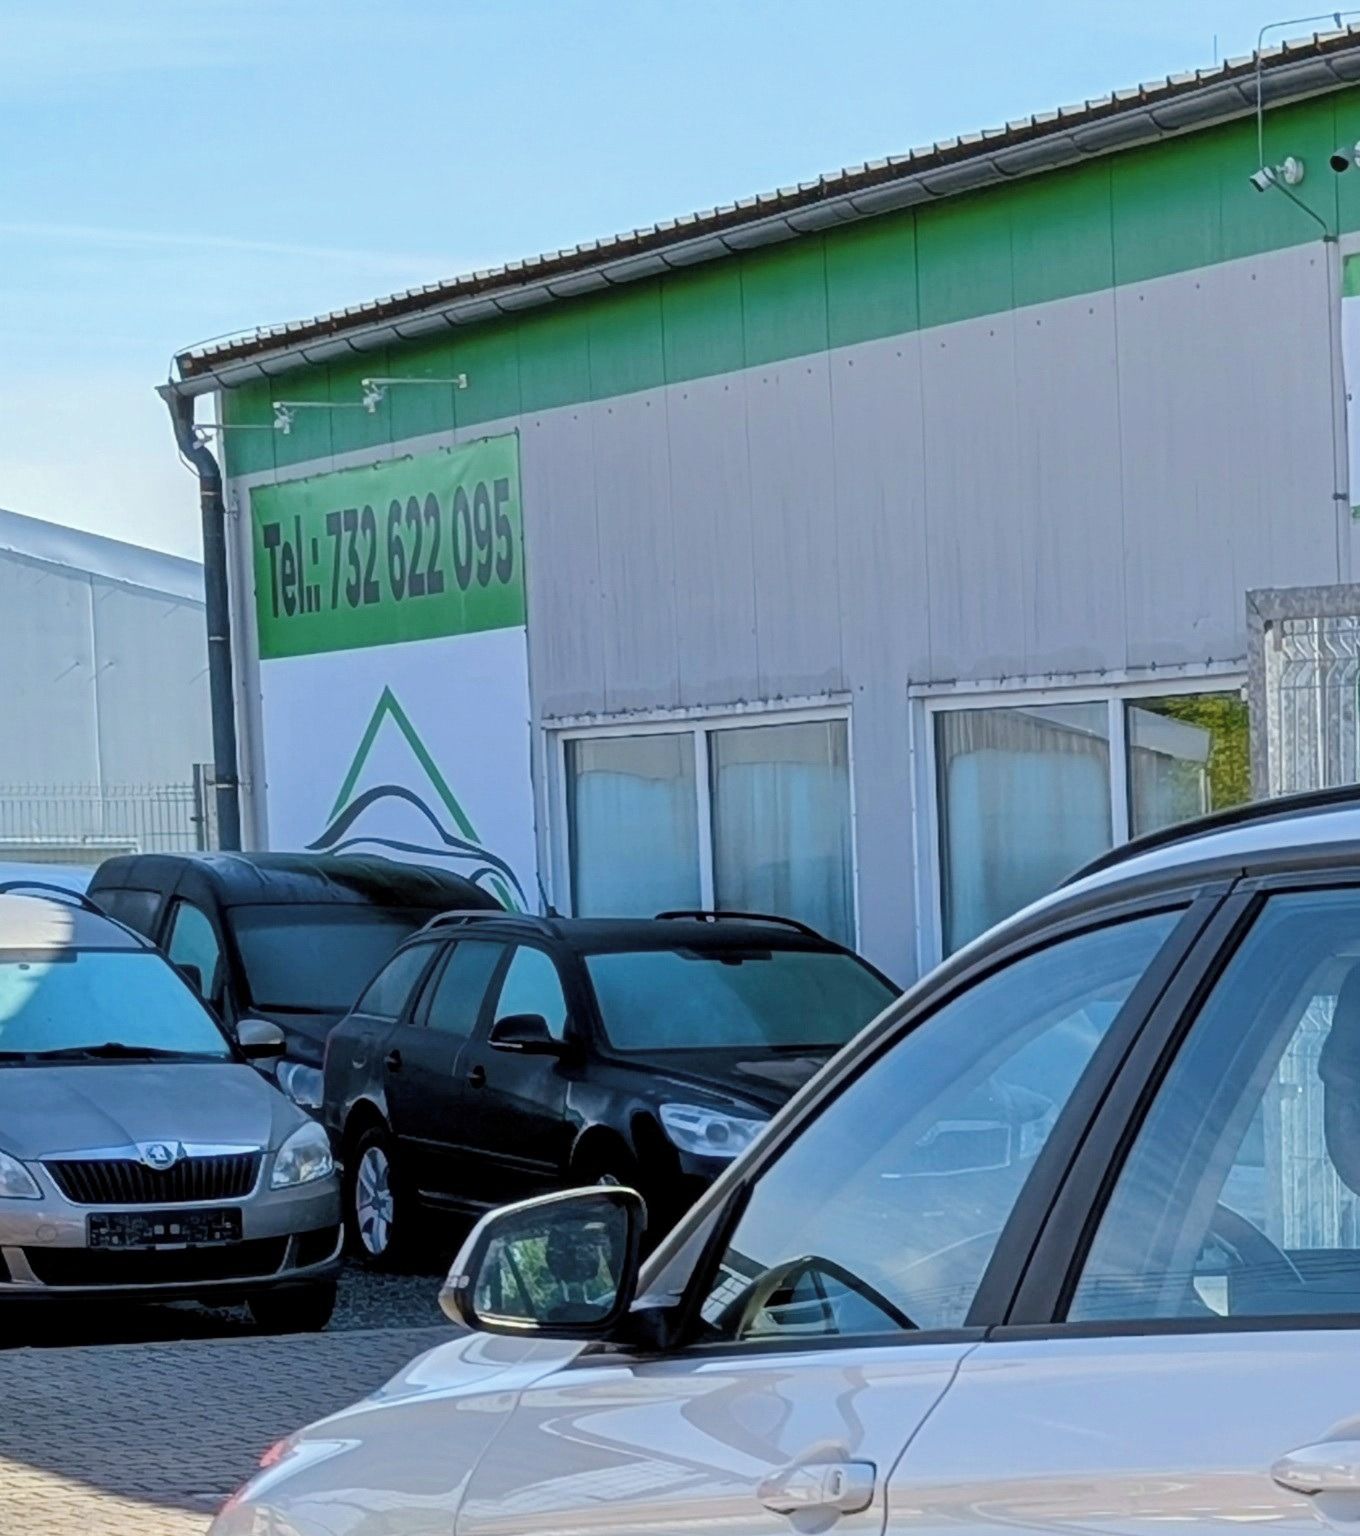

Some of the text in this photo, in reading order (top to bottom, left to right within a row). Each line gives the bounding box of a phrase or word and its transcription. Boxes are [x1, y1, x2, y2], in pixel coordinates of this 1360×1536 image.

[263, 478, 513, 618] Tel.: 732 622 095
